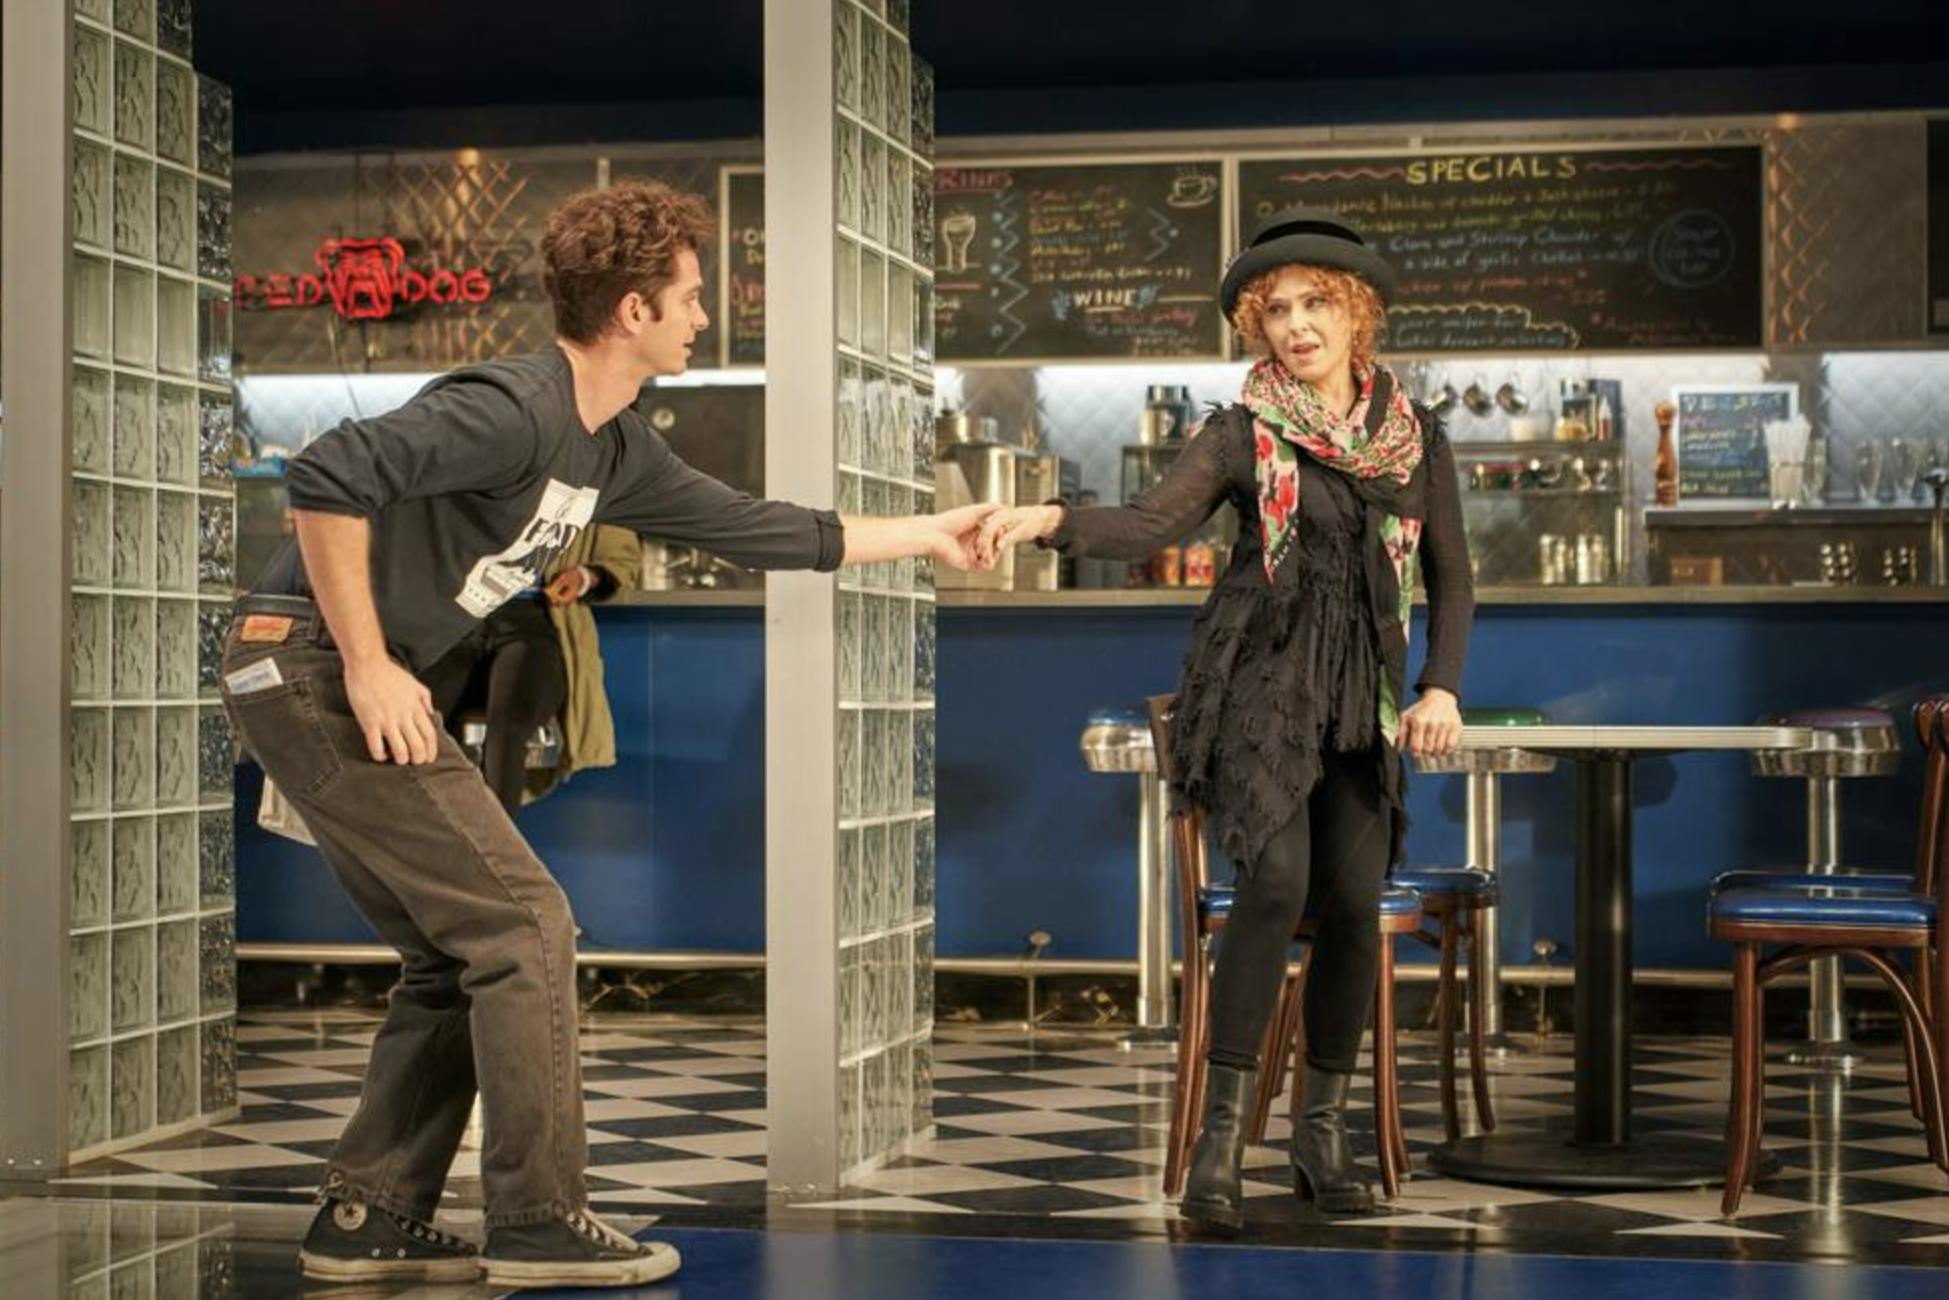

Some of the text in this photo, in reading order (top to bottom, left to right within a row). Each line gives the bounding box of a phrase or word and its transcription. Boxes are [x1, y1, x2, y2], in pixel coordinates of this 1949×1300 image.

[1406, 156, 1576, 184] SPECIALS
[401, 268, 491, 303] DOG
[1074, 288, 1137, 307] WINE
